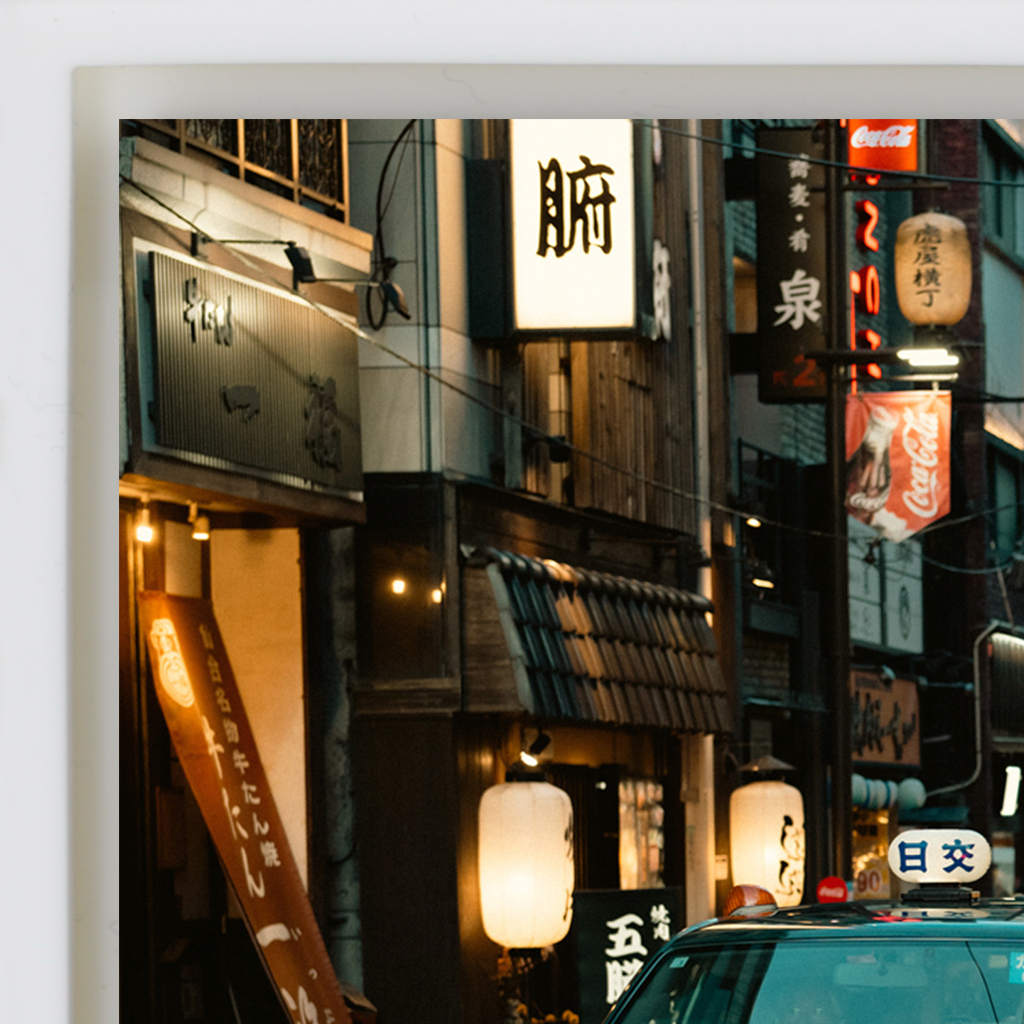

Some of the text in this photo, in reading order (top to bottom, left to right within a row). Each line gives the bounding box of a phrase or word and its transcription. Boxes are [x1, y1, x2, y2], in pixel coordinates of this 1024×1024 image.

[536, 155, 616, 258] 腑
[773, 269, 823, 331] 泉
[898, 839, 975, 873] 日交
